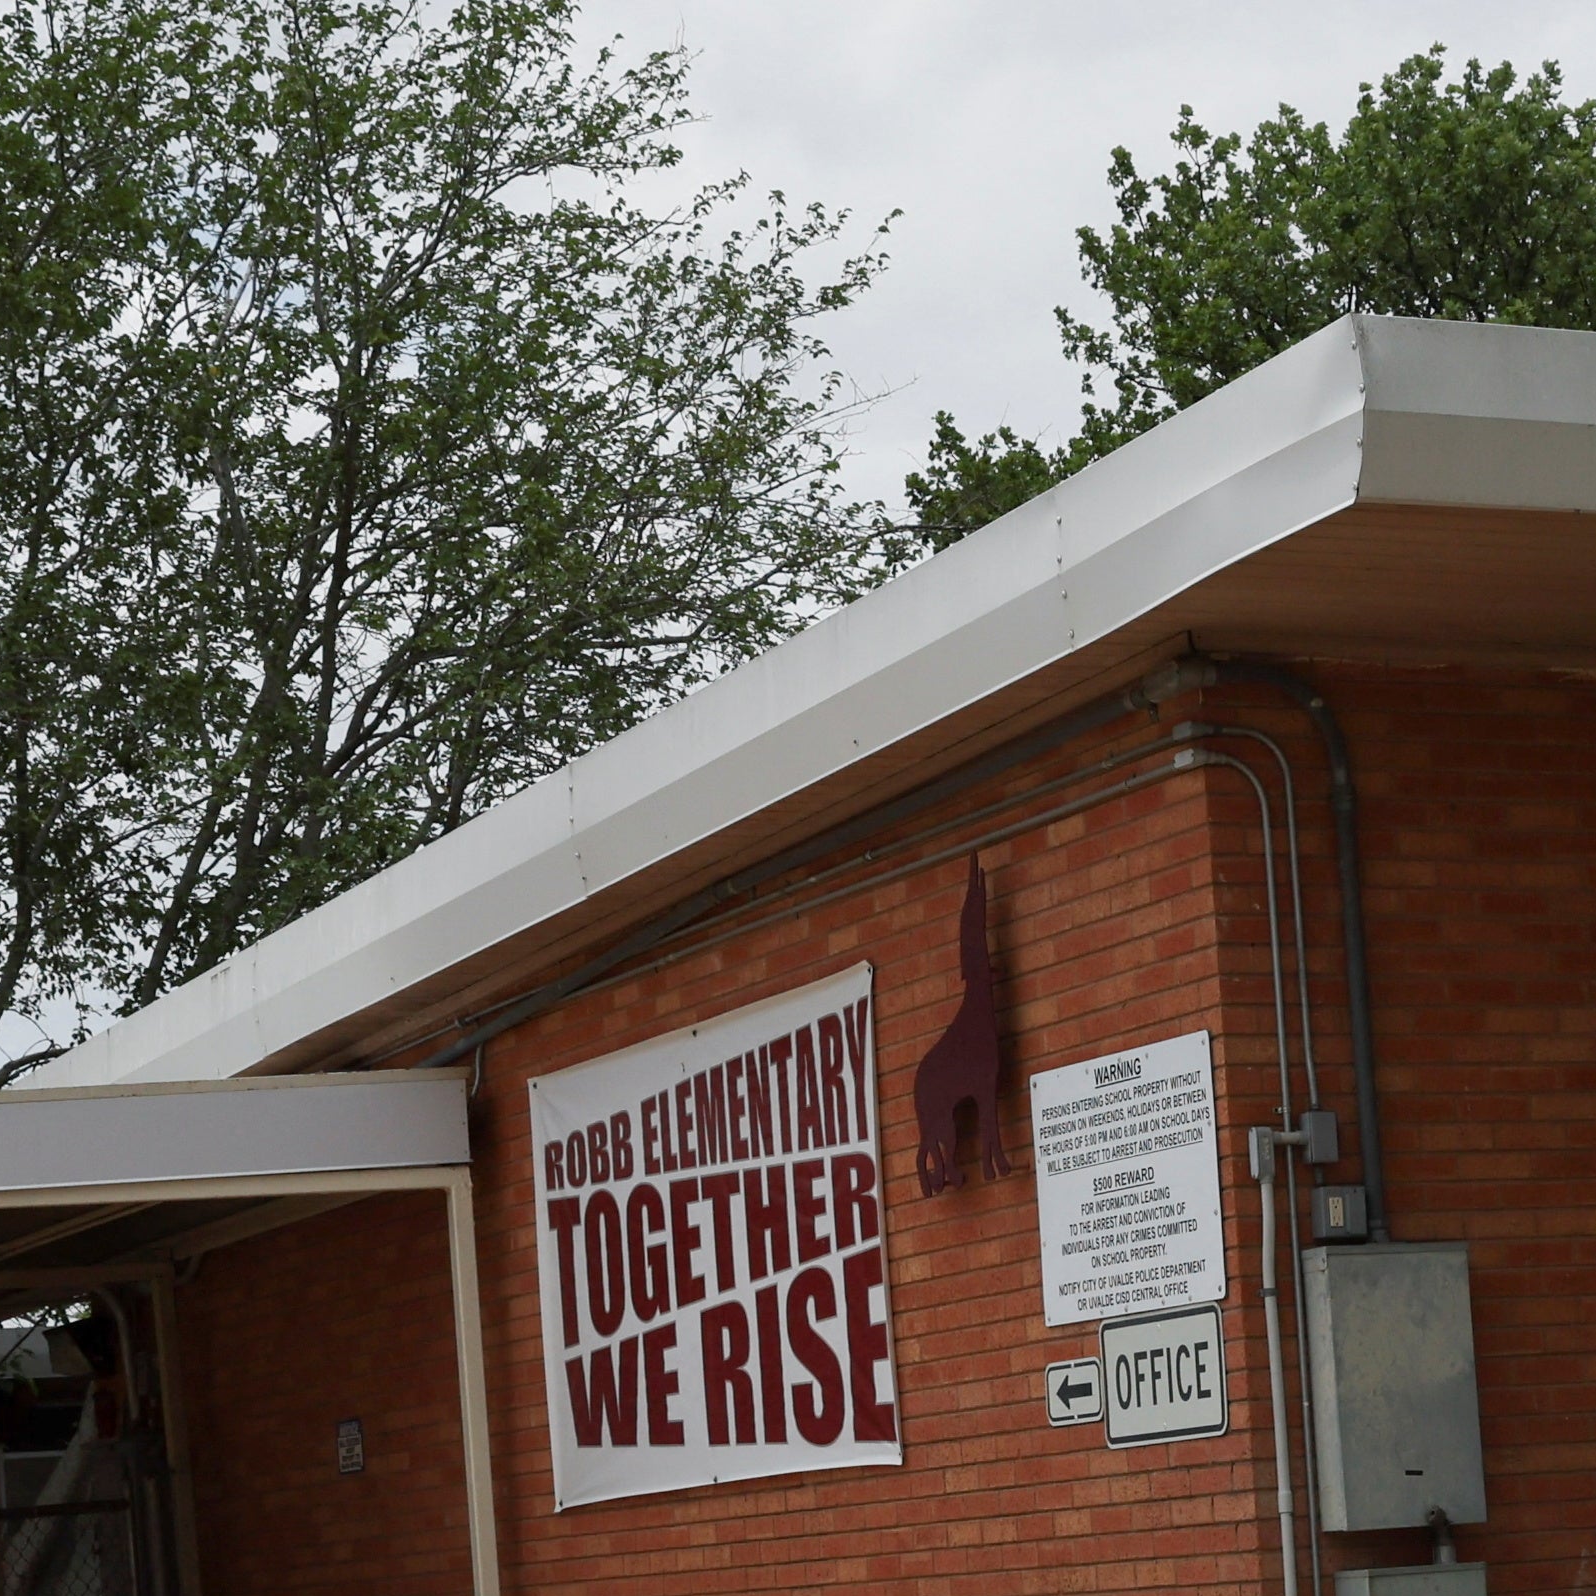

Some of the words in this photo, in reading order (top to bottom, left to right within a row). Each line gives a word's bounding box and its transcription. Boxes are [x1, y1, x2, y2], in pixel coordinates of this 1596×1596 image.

[1094, 1058, 1141, 1085] WARNING
[544, 1110, 634, 1192] ROBB
[640, 994, 869, 1176] ELEMENTARY
[1042, 1102, 1071, 1120] PERSONS
[1072, 1094, 1103, 1113] ENTERING
[1104, 1087, 1132, 1105] SCHOOL
[1133, 1078, 1169, 1099] PROPERTY
[1170, 1070, 1201, 1090] WITHOUT
[1039, 1119, 1077, 1139] PERMISSION
[1078, 1116, 1087, 1131] ON
[1088, 1107, 1126, 1128] WEEKENDS,
[1127, 1099, 1160, 1119] HOLIDAYS
[1162, 1097, 1172, 1111] OR
[1173, 1088, 1207, 1109] BETWEEN
[1039, 1143, 1051, 1156] THE
[1052, 1138, 1073, 1153] HOURS
[1074, 1136, 1083, 1148] OF
[1084, 1132, 1097, 1146] 5:00
[1098, 1130, 1108, 1143] PM
[1109, 1127, 1123, 1141] AND
[1124, 1123, 1137, 1137] 6:00
[1138, 1121, 1149, 1134] AM
[1150, 1118, 1160, 1131] ON
[1161, 1111, 1190, 1129] SCHOOL
[1191, 1107, 1210, 1122] DAYS
[1047, 1158, 1062, 1172] WILL
[1063, 1156, 1071, 1169] BE
[1072, 1150, 1101, 1167] SUBJECT
[1102, 1148, 1110, 1161] TO
[1111, 1142, 1138, 1158] ARREST
[1139, 1138, 1153, 1153] AND
[1154, 1127, 1203, 1149] PROSECUTION
[1093, 1175, 1112, 1192] $500
[1114, 1167, 1155, 1188] REWARD
[1069, 1223, 1078, 1235] TO
[1079, 1220, 1092, 1233] THE
[1092, 1215, 1118, 1231] ARREST
[1119, 1212, 1133, 1226] AND
[1134, 1204, 1175, 1223] CONVICTION
[1176, 1202, 1186, 1215] OF
[1081, 1202, 1094, 1215] FOR
[1095, 1193, 1139, 1212] INFORMATION
[1140, 1186, 1170, 1203] LEADING
[547, 1152, 880, 1349] TOGETHER
[1062, 1237, 1100, 1255] INDIVIDUALS
[1101, 1234, 1116, 1247] FOR
[1115, 1232, 1129, 1245] ANY
[1130, 1227, 1156, 1242] CRIMES
[1157, 1219, 1197, 1237] COMMITTED
[1091, 1255, 1101, 1267] ON
[1102, 1250, 1129, 1265] SCHOOL
[1131, 1243, 1167, 1260] PROPERTY.
[1059, 1281, 1081, 1295] NOTIFY
[1082, 1278, 1097, 1291] CITY
[1098, 1276, 1107, 1289] OF
[1108, 1272, 1134, 1287] UVALDE
[1135, 1267, 1159, 1282] POLICE
[1161, 1259, 1206, 1278] DEPARTMENT
[1078, 1298, 1087, 1310] OR
[1088, 1293, 1114, 1308] UVALDE
[1115, 1291, 1130, 1304] CISD
[1131, 1285, 1163, 1301] CENTRAL
[1164, 1281, 1188, 1296] OFFICE
[565, 1321, 685, 1448] WE
[700, 1246, 897, 1448] RISE
[1115, 1341, 1212, 1410] OFFICE
